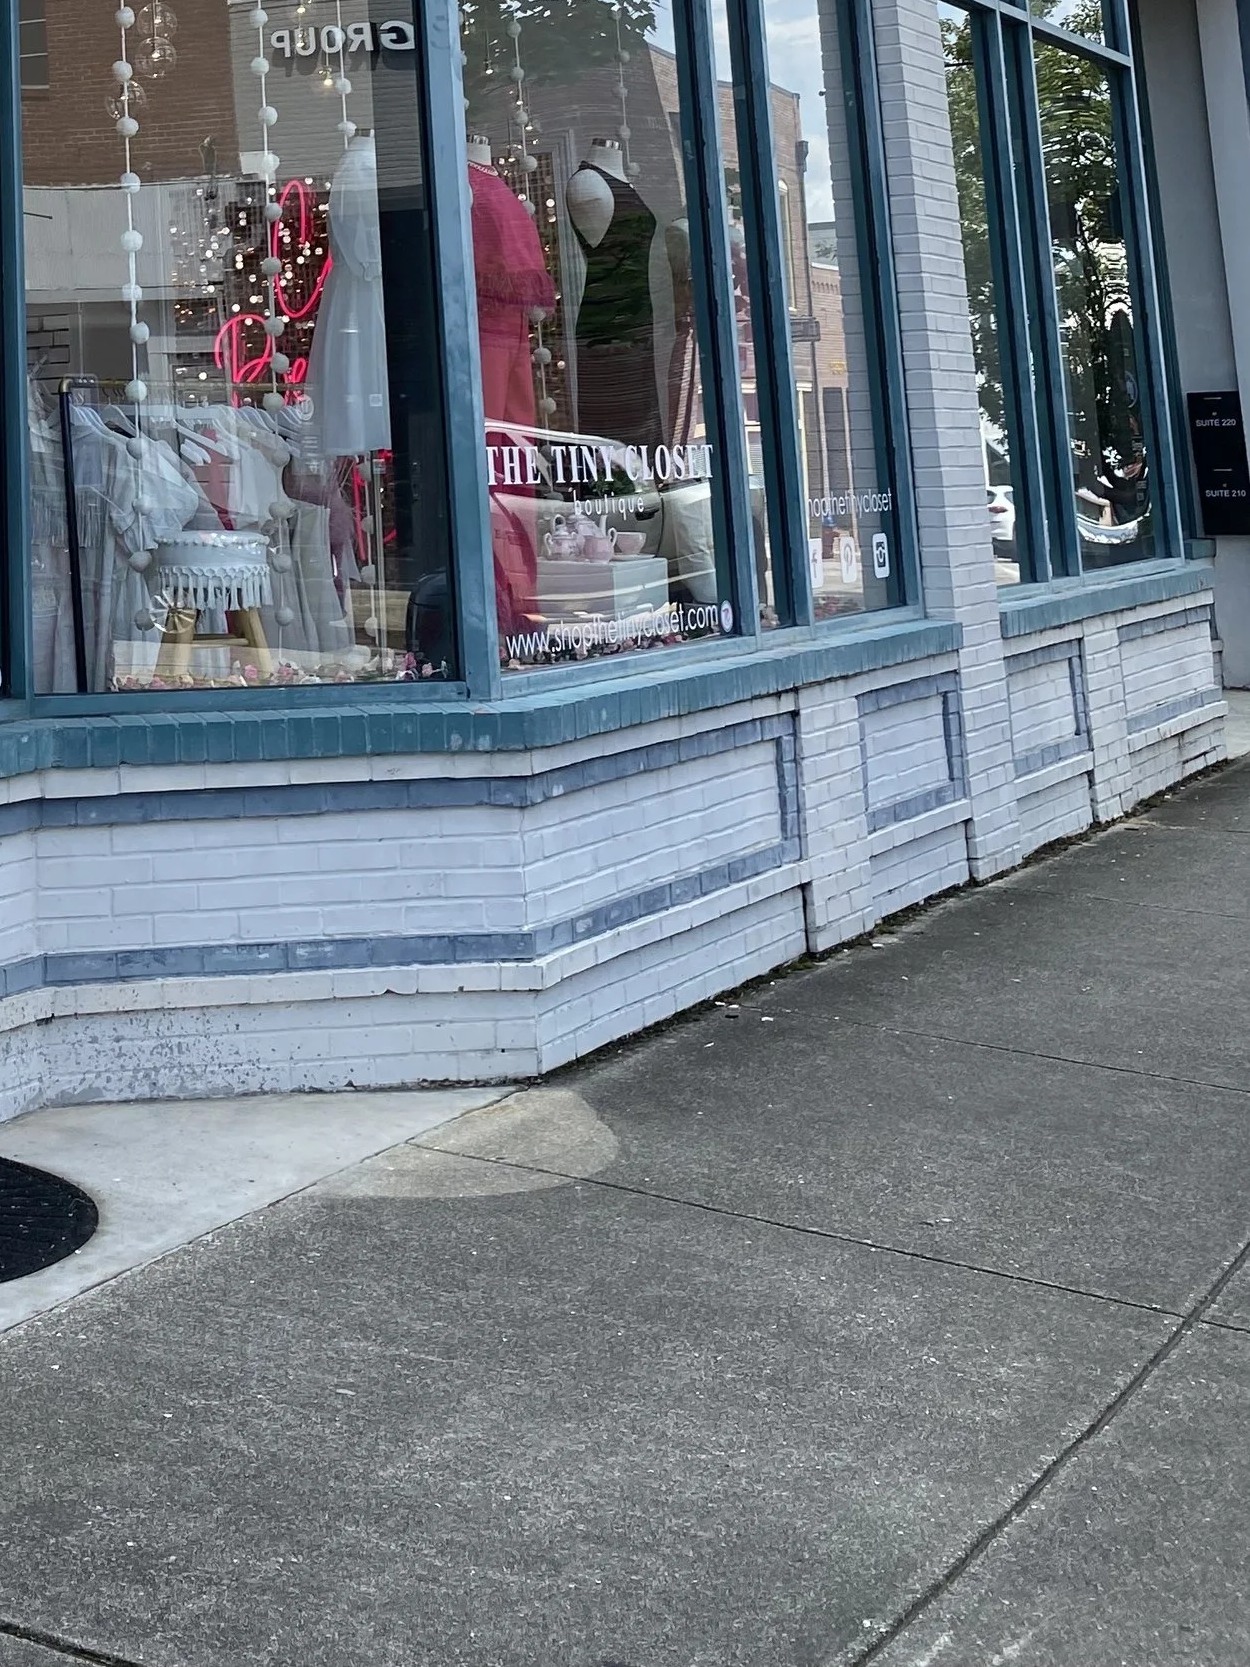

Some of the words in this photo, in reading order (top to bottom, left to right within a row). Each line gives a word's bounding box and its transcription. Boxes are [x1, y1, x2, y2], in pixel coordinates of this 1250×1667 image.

[1195, 419, 1220, 427] SUITE
[1221, 418, 1236, 426] 220
[486, 446, 541, 485] THE
[550, 445, 614, 484] TINY
[624, 444, 713, 481] CLOSET
[573, 489, 644, 520] boutique
[807, 487, 892, 519] hopthetinycloset
[1205, 490, 1230, 498] SUITE
[1231, 489, 1246, 497] 210
[506, 603, 719, 659] www.shopthetinycloset.com
